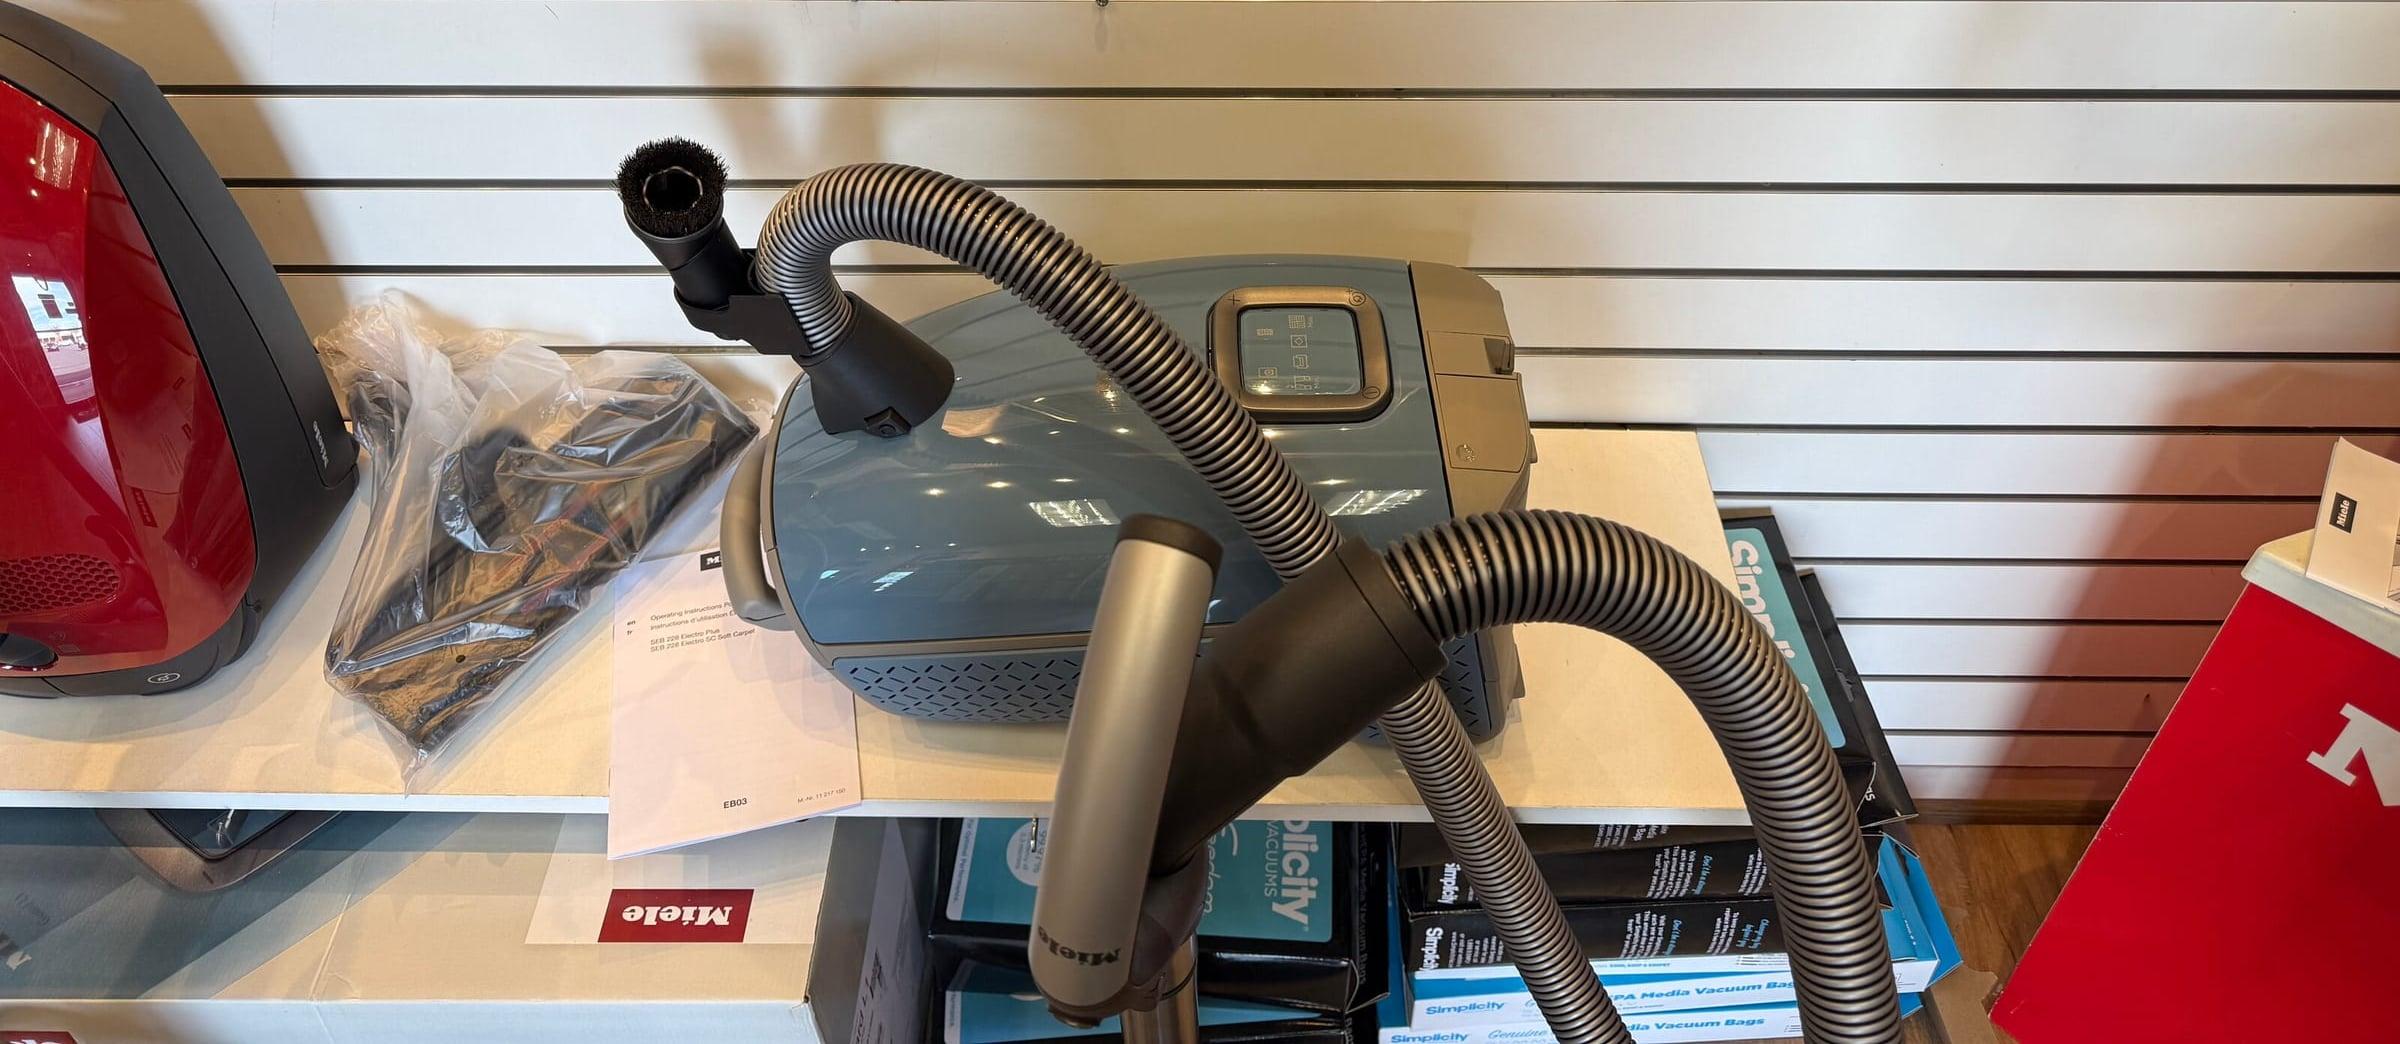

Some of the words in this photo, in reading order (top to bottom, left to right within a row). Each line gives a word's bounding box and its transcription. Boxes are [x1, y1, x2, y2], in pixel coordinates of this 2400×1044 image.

[2336, 500, 2350, 527] Miele
[706, 555, 722, 566] M
[650, 610, 683, 621] Operating
[684, 604, 722, 615] Instructions
[650, 619, 689, 631] Instructions
[681, 631, 704, 640] Electro
[681, 638, 704, 647] Electro
[733, 628, 755, 638] Carpet
[723, 797, 748, 809] EB03
[1264, 820, 1279, 897] VACUUMS
[621, 905, 733, 926] Miele
[1357, 903, 1368, 951] Vacuum
[1038, 925, 1121, 966] Miele
[1419, 927, 1443, 971] Simplicity
[1357, 953, 1369, 985] Bags
[1641, 989, 1690, 999] Media
[1695, 982, 1762, 995] Vacuum
[1426, 1001, 1504, 1015] Simplicity
[1391, 1032, 1468, 1044] Simplicity
[1487, 1029, 1548, 1040] Genuine
[1655, 1019, 1720, 1031] Vacuum
[1724, 1016, 1765, 1026] Bags
